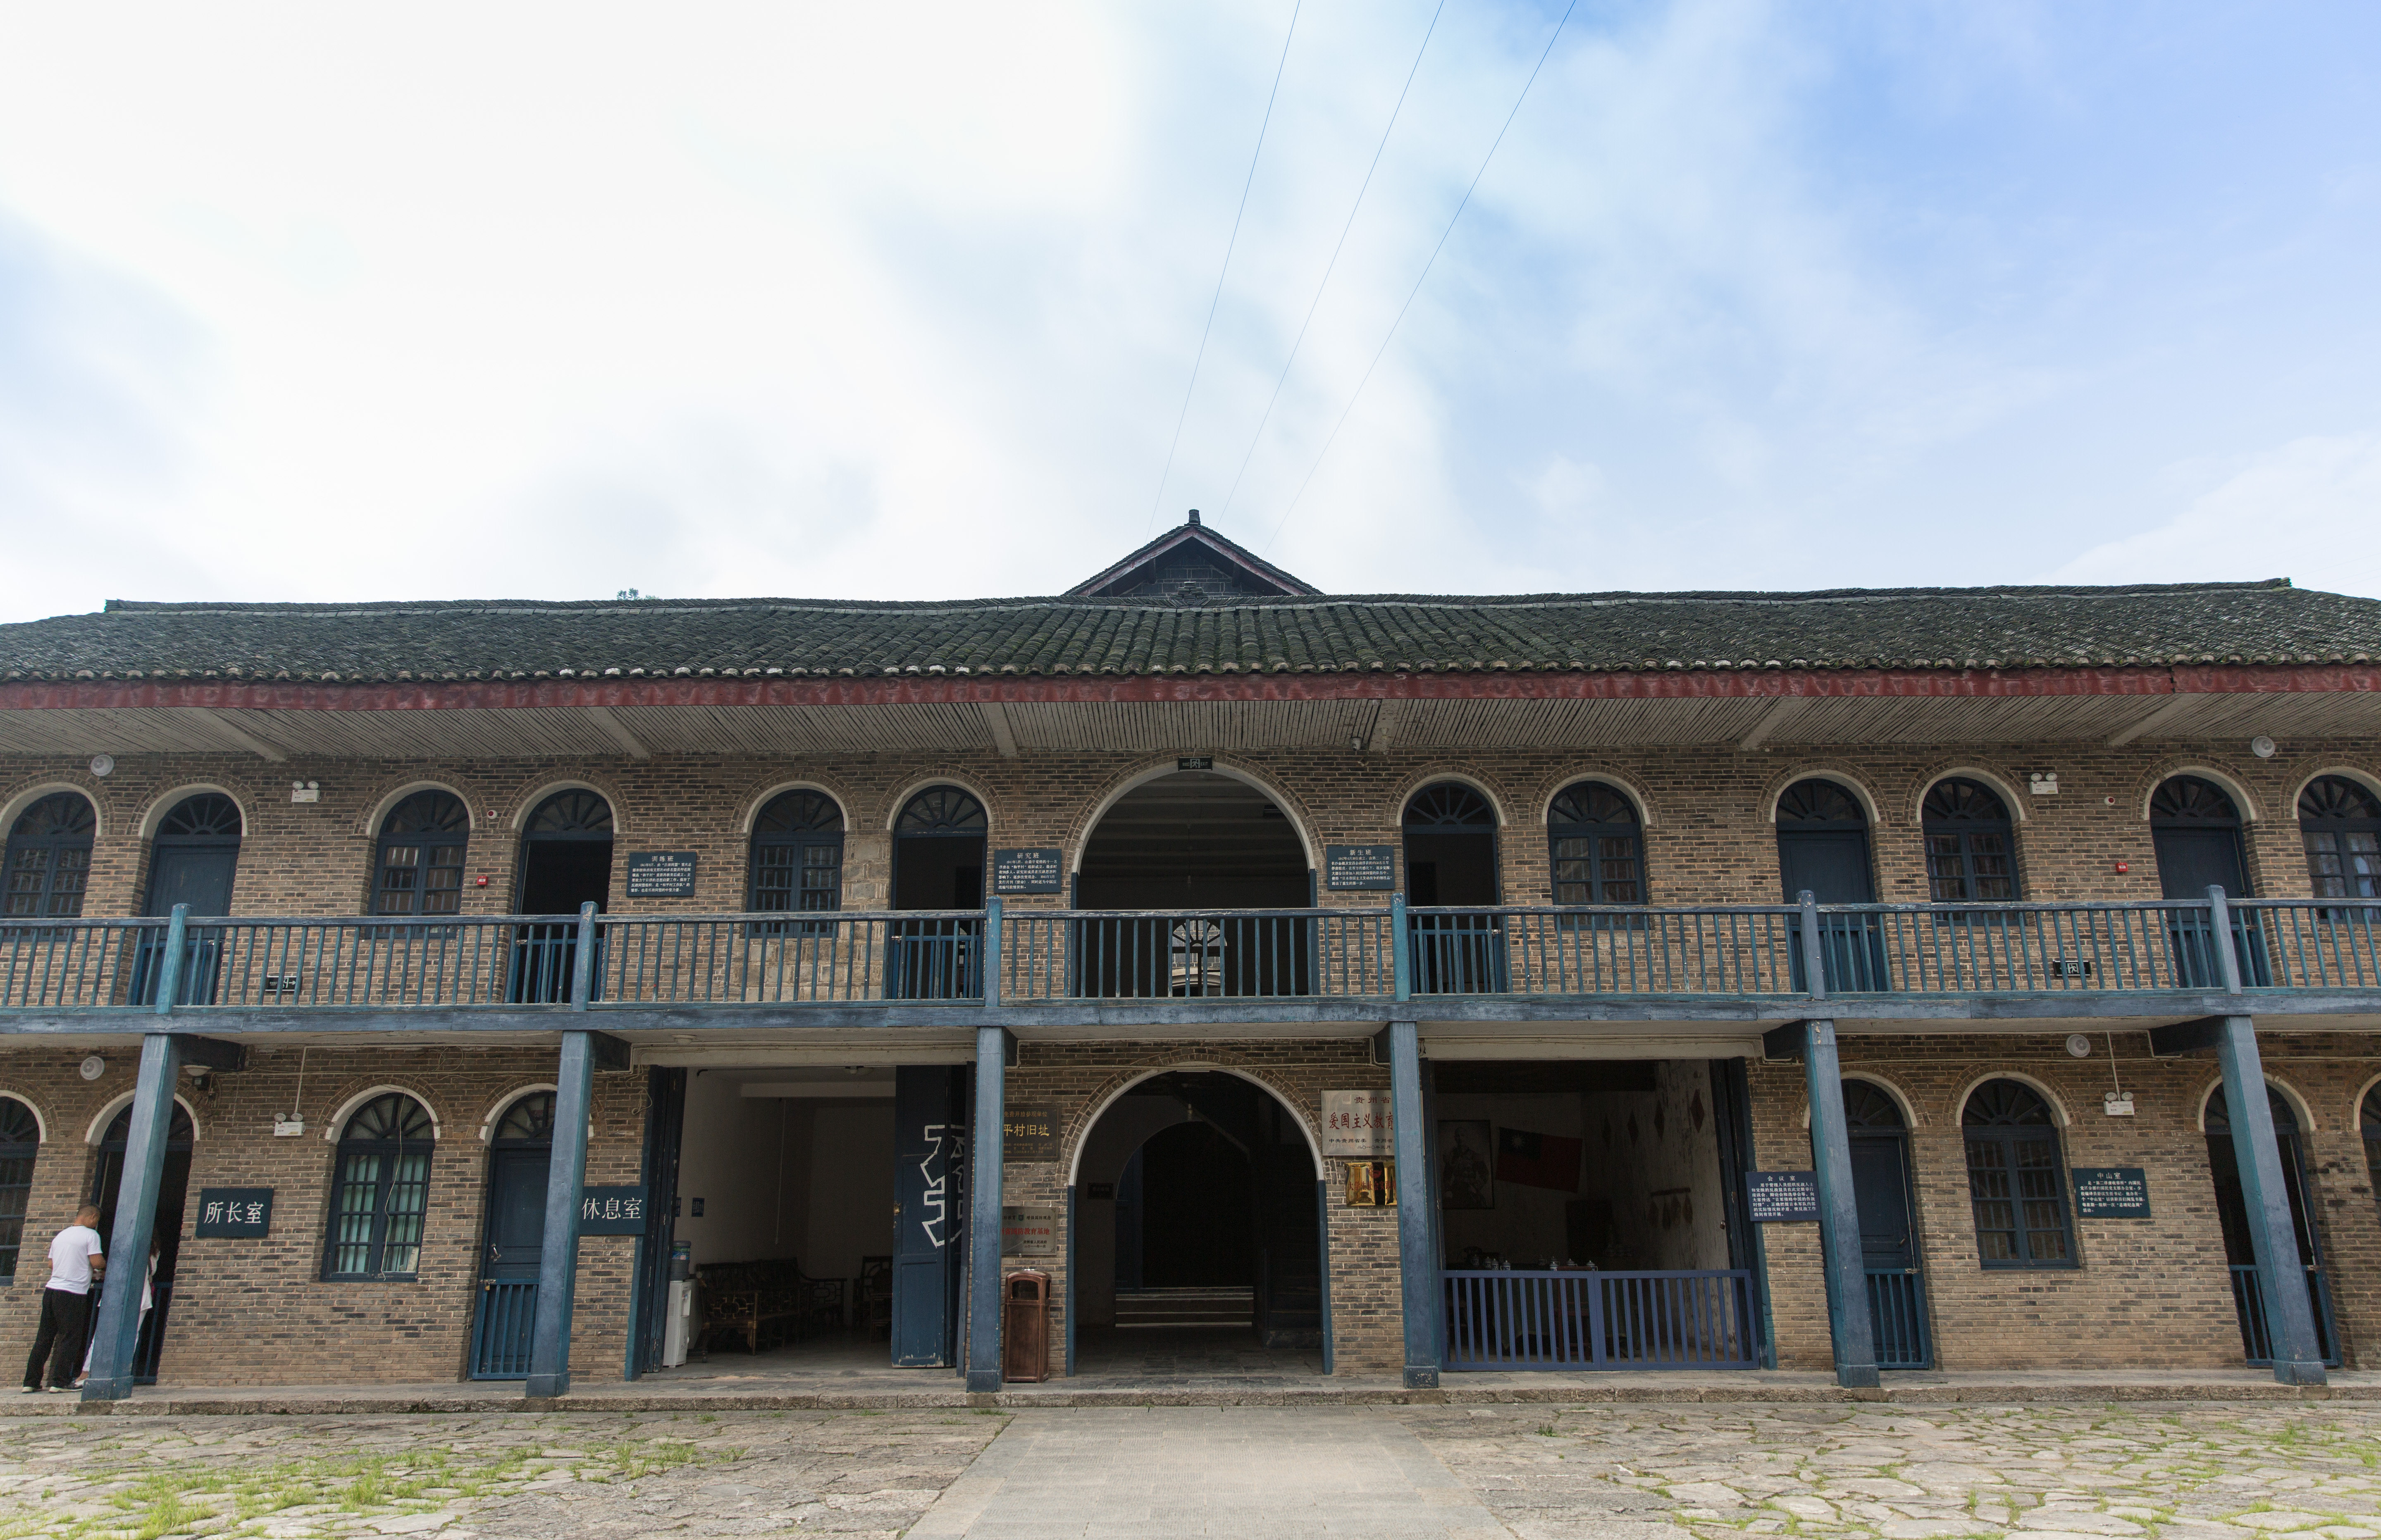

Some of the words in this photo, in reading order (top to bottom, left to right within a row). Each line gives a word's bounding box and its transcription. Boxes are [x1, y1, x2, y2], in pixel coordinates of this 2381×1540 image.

[1004, 1123, 1050, 1137] 平村旧址
[1329, 1111, 1393, 1130] 爱国主义教育
[204, 1201, 264, 1223] 所长室
[581, 1197, 642, 1219] 休息室
